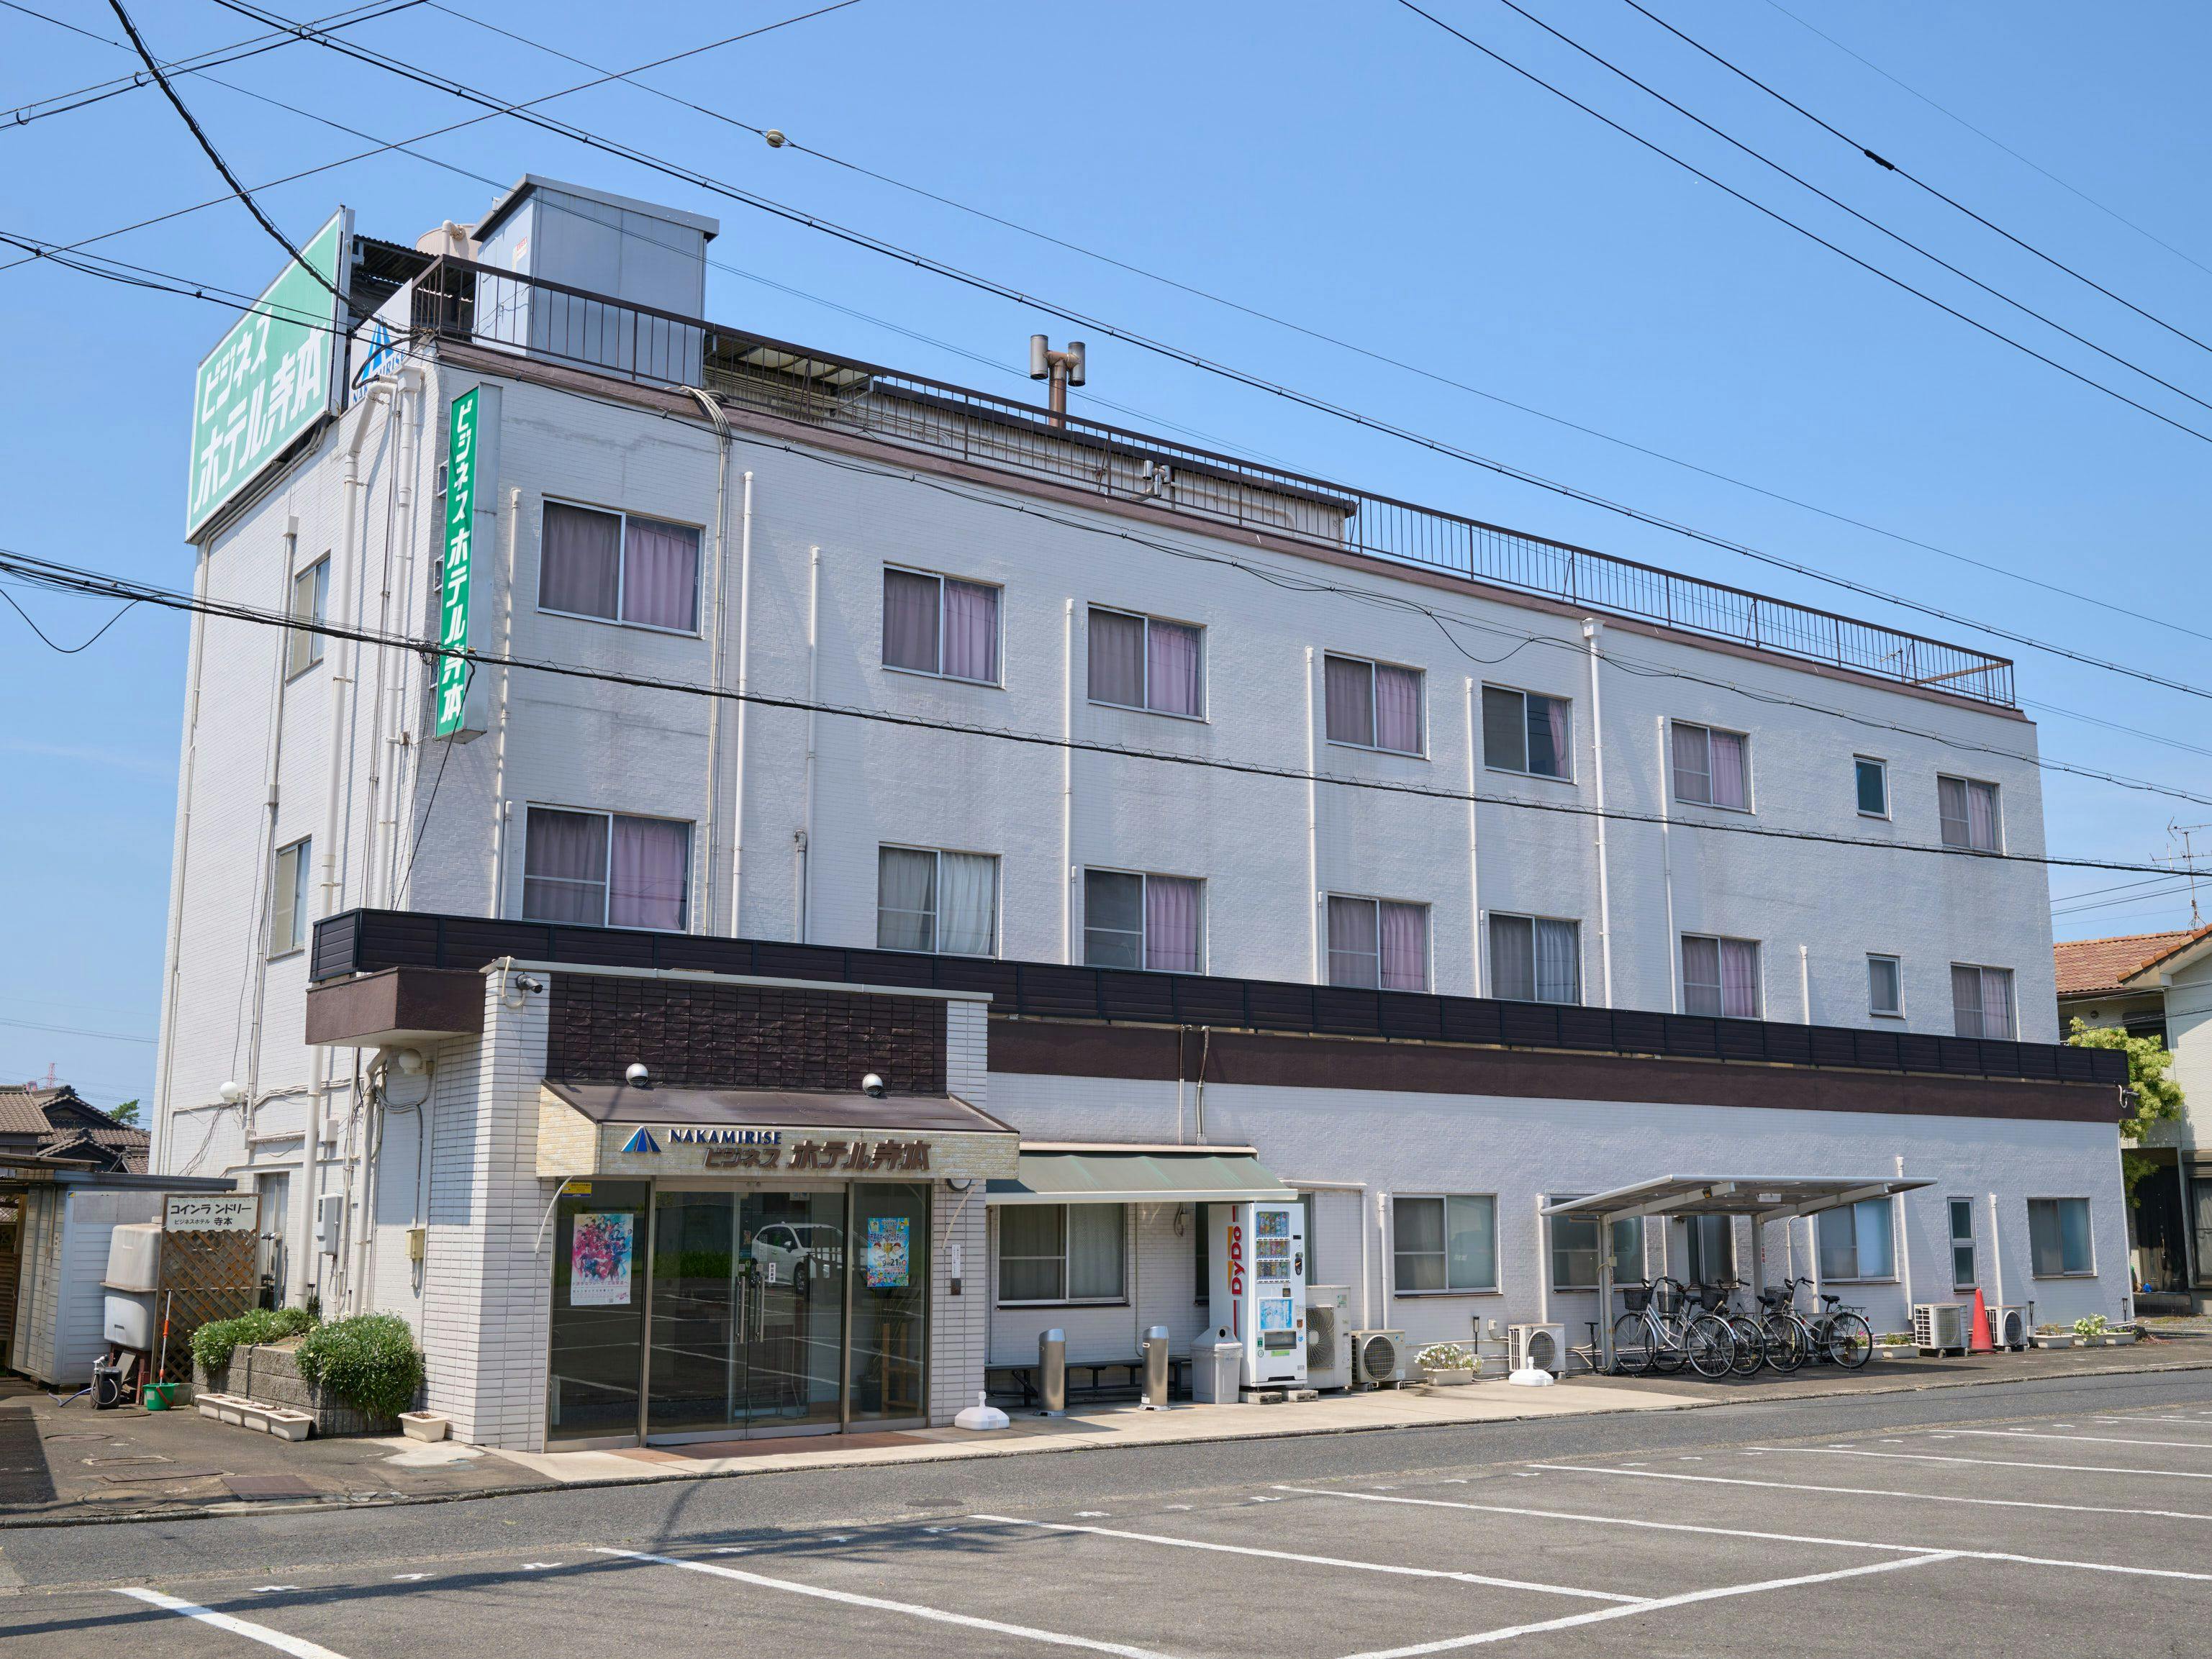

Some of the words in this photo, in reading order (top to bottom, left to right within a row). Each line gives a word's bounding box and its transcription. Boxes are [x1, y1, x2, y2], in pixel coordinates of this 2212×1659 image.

[201, 305, 272, 424] ビジネス
[194, 322, 326, 514] ホテル寺本
[668, 1129, 781, 1145] NAKAMIRISE
[704, 1147, 781, 1168] ビジネス
[787, 1140, 931, 1170] ホテル寺本
[171, 1204, 252, 1214] コインランドリー
[214, 1217, 233, 1226] 寺本
